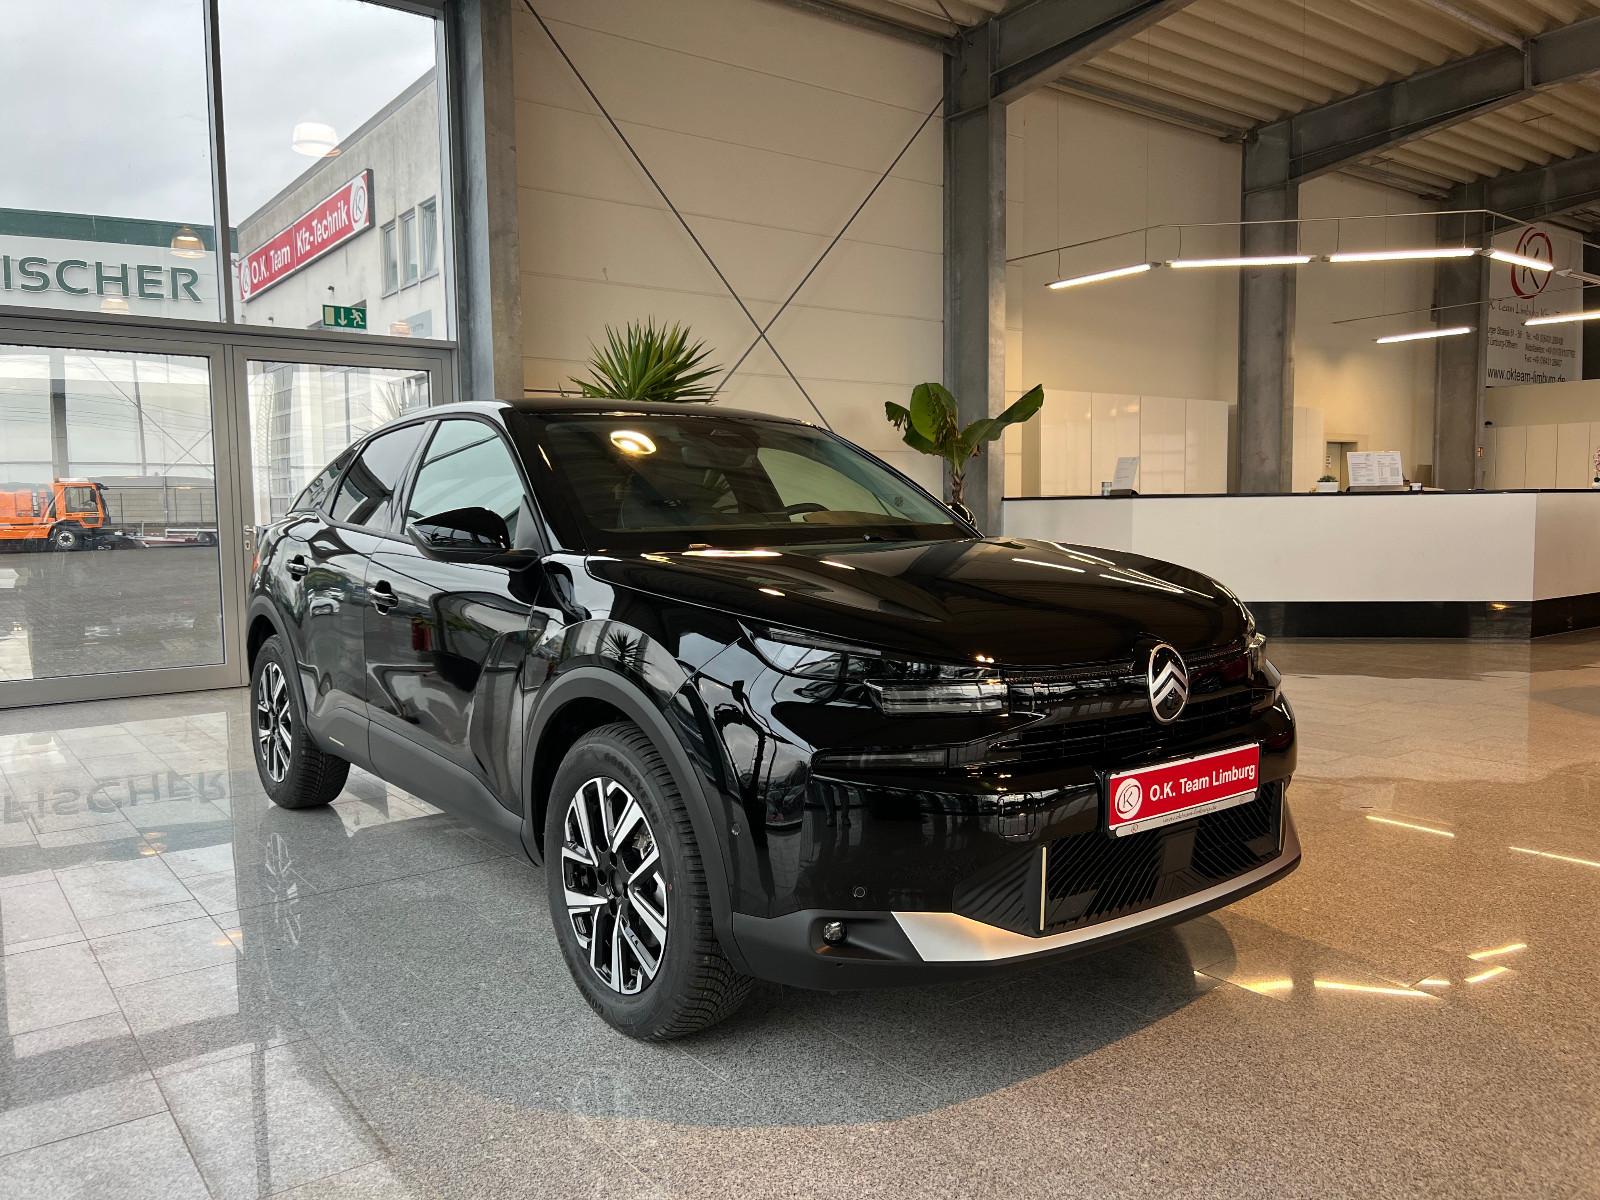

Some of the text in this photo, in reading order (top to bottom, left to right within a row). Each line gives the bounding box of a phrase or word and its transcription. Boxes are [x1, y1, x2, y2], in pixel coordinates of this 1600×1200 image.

[251, 255, 269, 284] O.K.
[270, 245, 291, 273] Team
[296, 200, 349, 257] Kfz-Technik
[3, 255, 202, 303] ISCHER
[1149, 781, 1176, 802] O.K.
[1180, 776, 1210, 794] Team
[1212, 764, 1256, 786] Limburg
